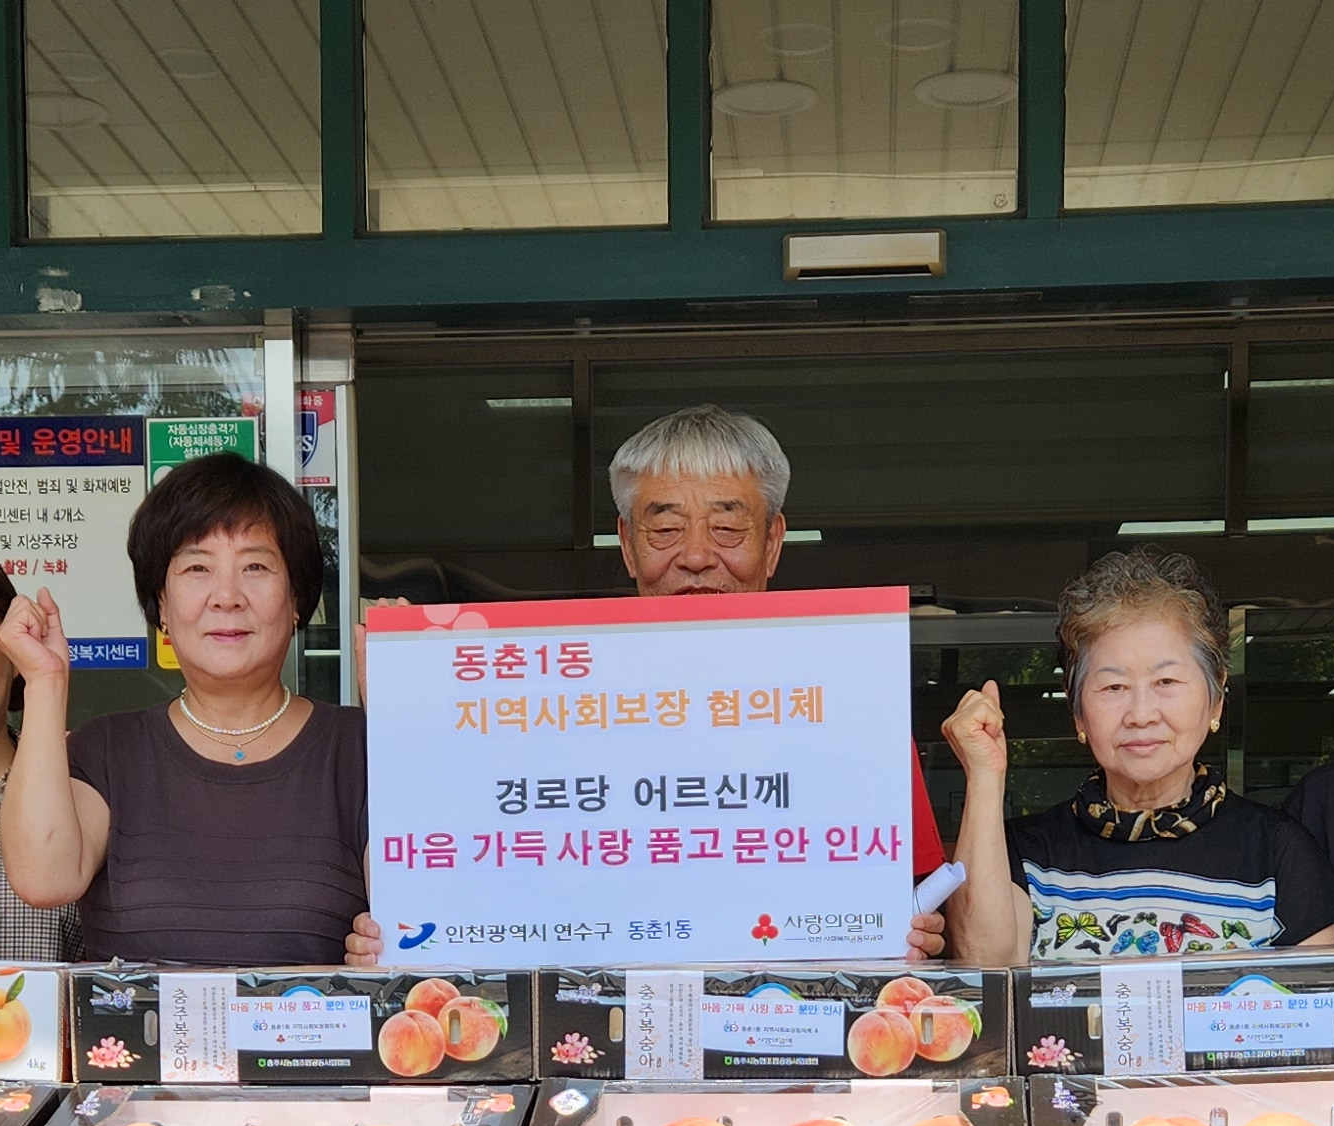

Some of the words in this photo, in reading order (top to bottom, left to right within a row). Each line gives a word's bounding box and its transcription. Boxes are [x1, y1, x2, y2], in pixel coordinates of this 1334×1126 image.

[303, 396, 323, 406] 화중
[168, 424, 238, 435] 자동심장충격기
[31, 427, 133, 455] 운영안내
[168, 435, 237, 447] (자동제세동기)
[38, 479, 62, 494] 범죄
[66, 478, 78, 493] 및
[83, 478, 132, 493] 화재예방
[36, 509, 48, 523] 내
[53, 508, 85, 523] 4개소
[0, 535, 12, 549] 및
[17, 533, 79, 550] 지상주차장
[4, 559, 28, 575] 촬영
[43, 559, 69, 574] 녹화
[452, 641, 593, 681] 동춘1동
[455, 688, 690, 734] 지역사회보장
[707, 685, 824, 727] 협의체
[496, 775, 610, 814] 경로당
[634, 771, 790, 813] 어르신께
[384, 832, 459, 869] 마음
[473, 832, 548, 867] 가득
[558, 829, 633, 866] 사랑
[647, 828, 723, 865] 품고
[733, 826, 810, 865] 문안
[825, 824, 903, 863] 인사
[445, 925, 547, 945] 인천광역시
[554, 922, 613, 942] 연수구
[627, 920, 692, 941] 동춘1동
[784, 913, 883, 934] 사랑의열매
[702, 1003, 720, 1013] 마음
[726, 1003, 745, 1013] 가득
[750, 1004, 769, 1014] 사랑
[774, 1004, 794, 1014] 품고
[798, 1005, 817, 1015] 문안
[823, 1005, 842, 1015] 인사
[172, 987, 190, 1072] 충주복숭아
[638, 984, 655, 1068] 충주복숭아
[1115, 982, 1134, 1068] 충주복숭아
[26, 1058, 46, 1071] 4kg
